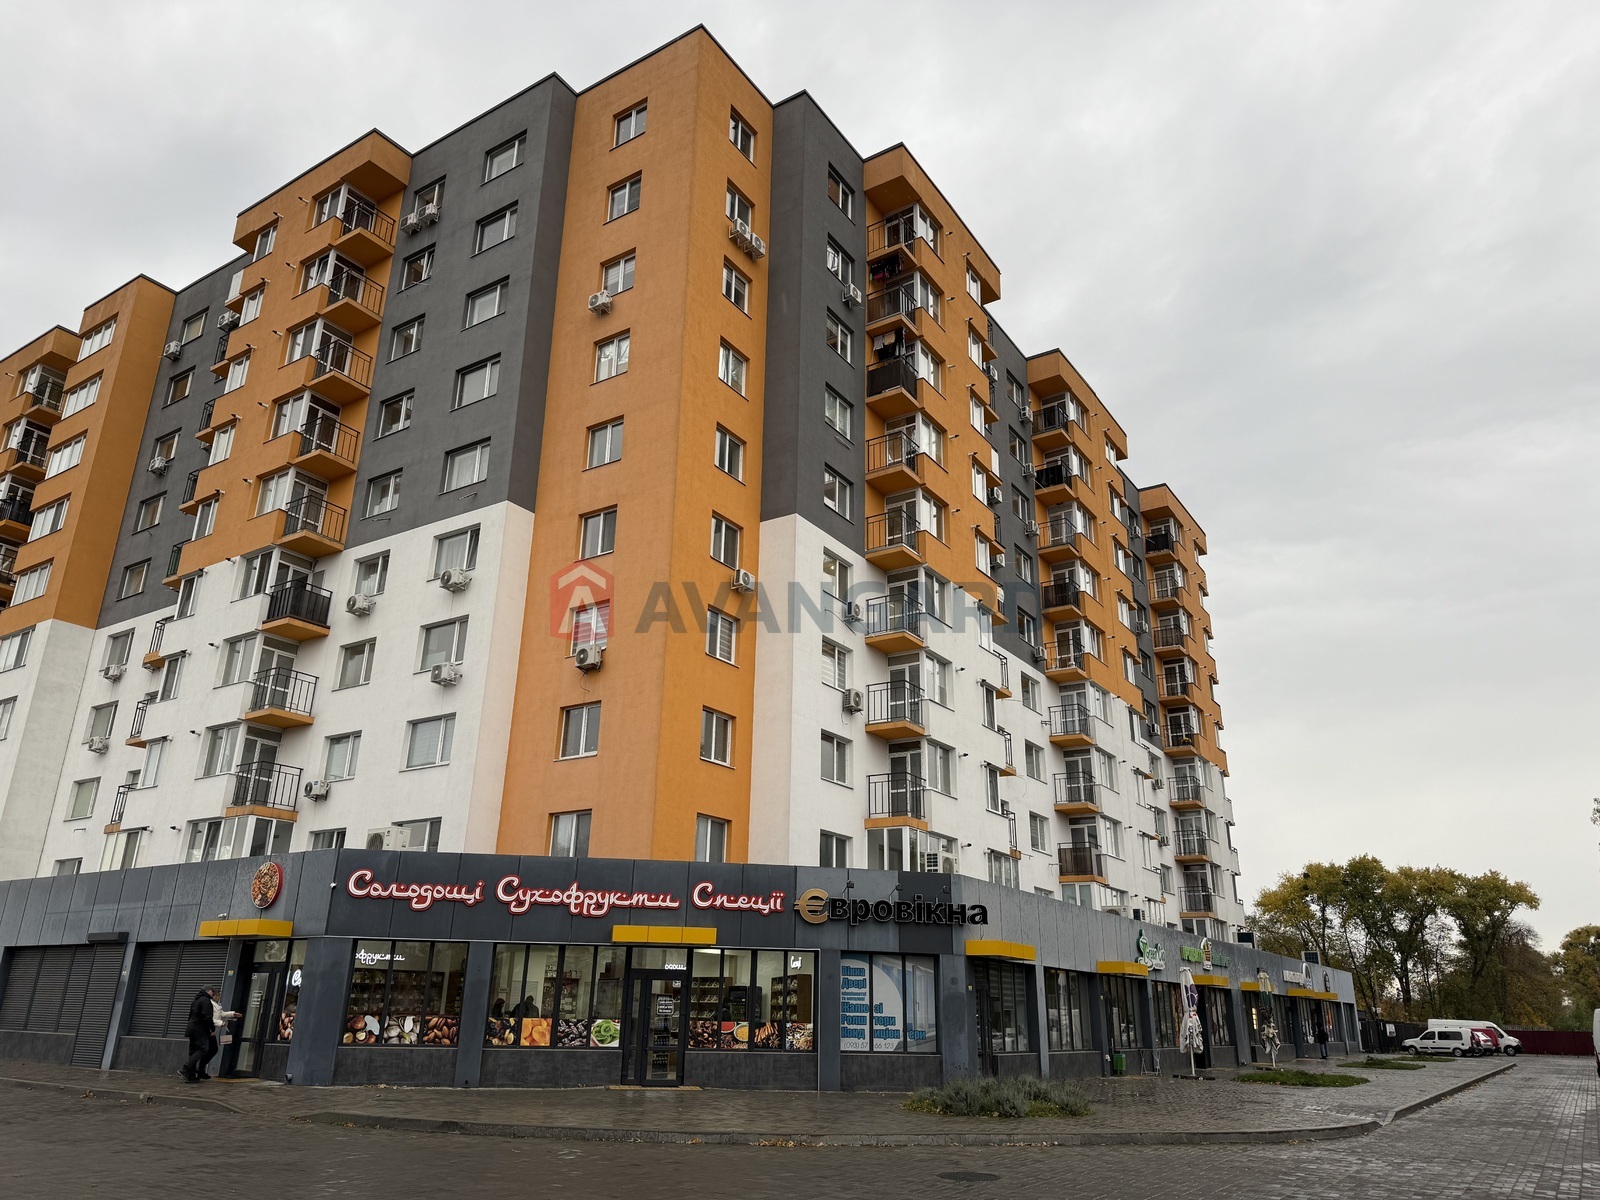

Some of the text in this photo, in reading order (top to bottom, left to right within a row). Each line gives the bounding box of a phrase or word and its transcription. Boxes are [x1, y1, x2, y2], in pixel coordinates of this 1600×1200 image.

[347, 868, 785, 916] Солодощі Сухофрукти Спеції
[841, 966, 865, 976] Вікна
[841, 978, 866, 989] Двері
